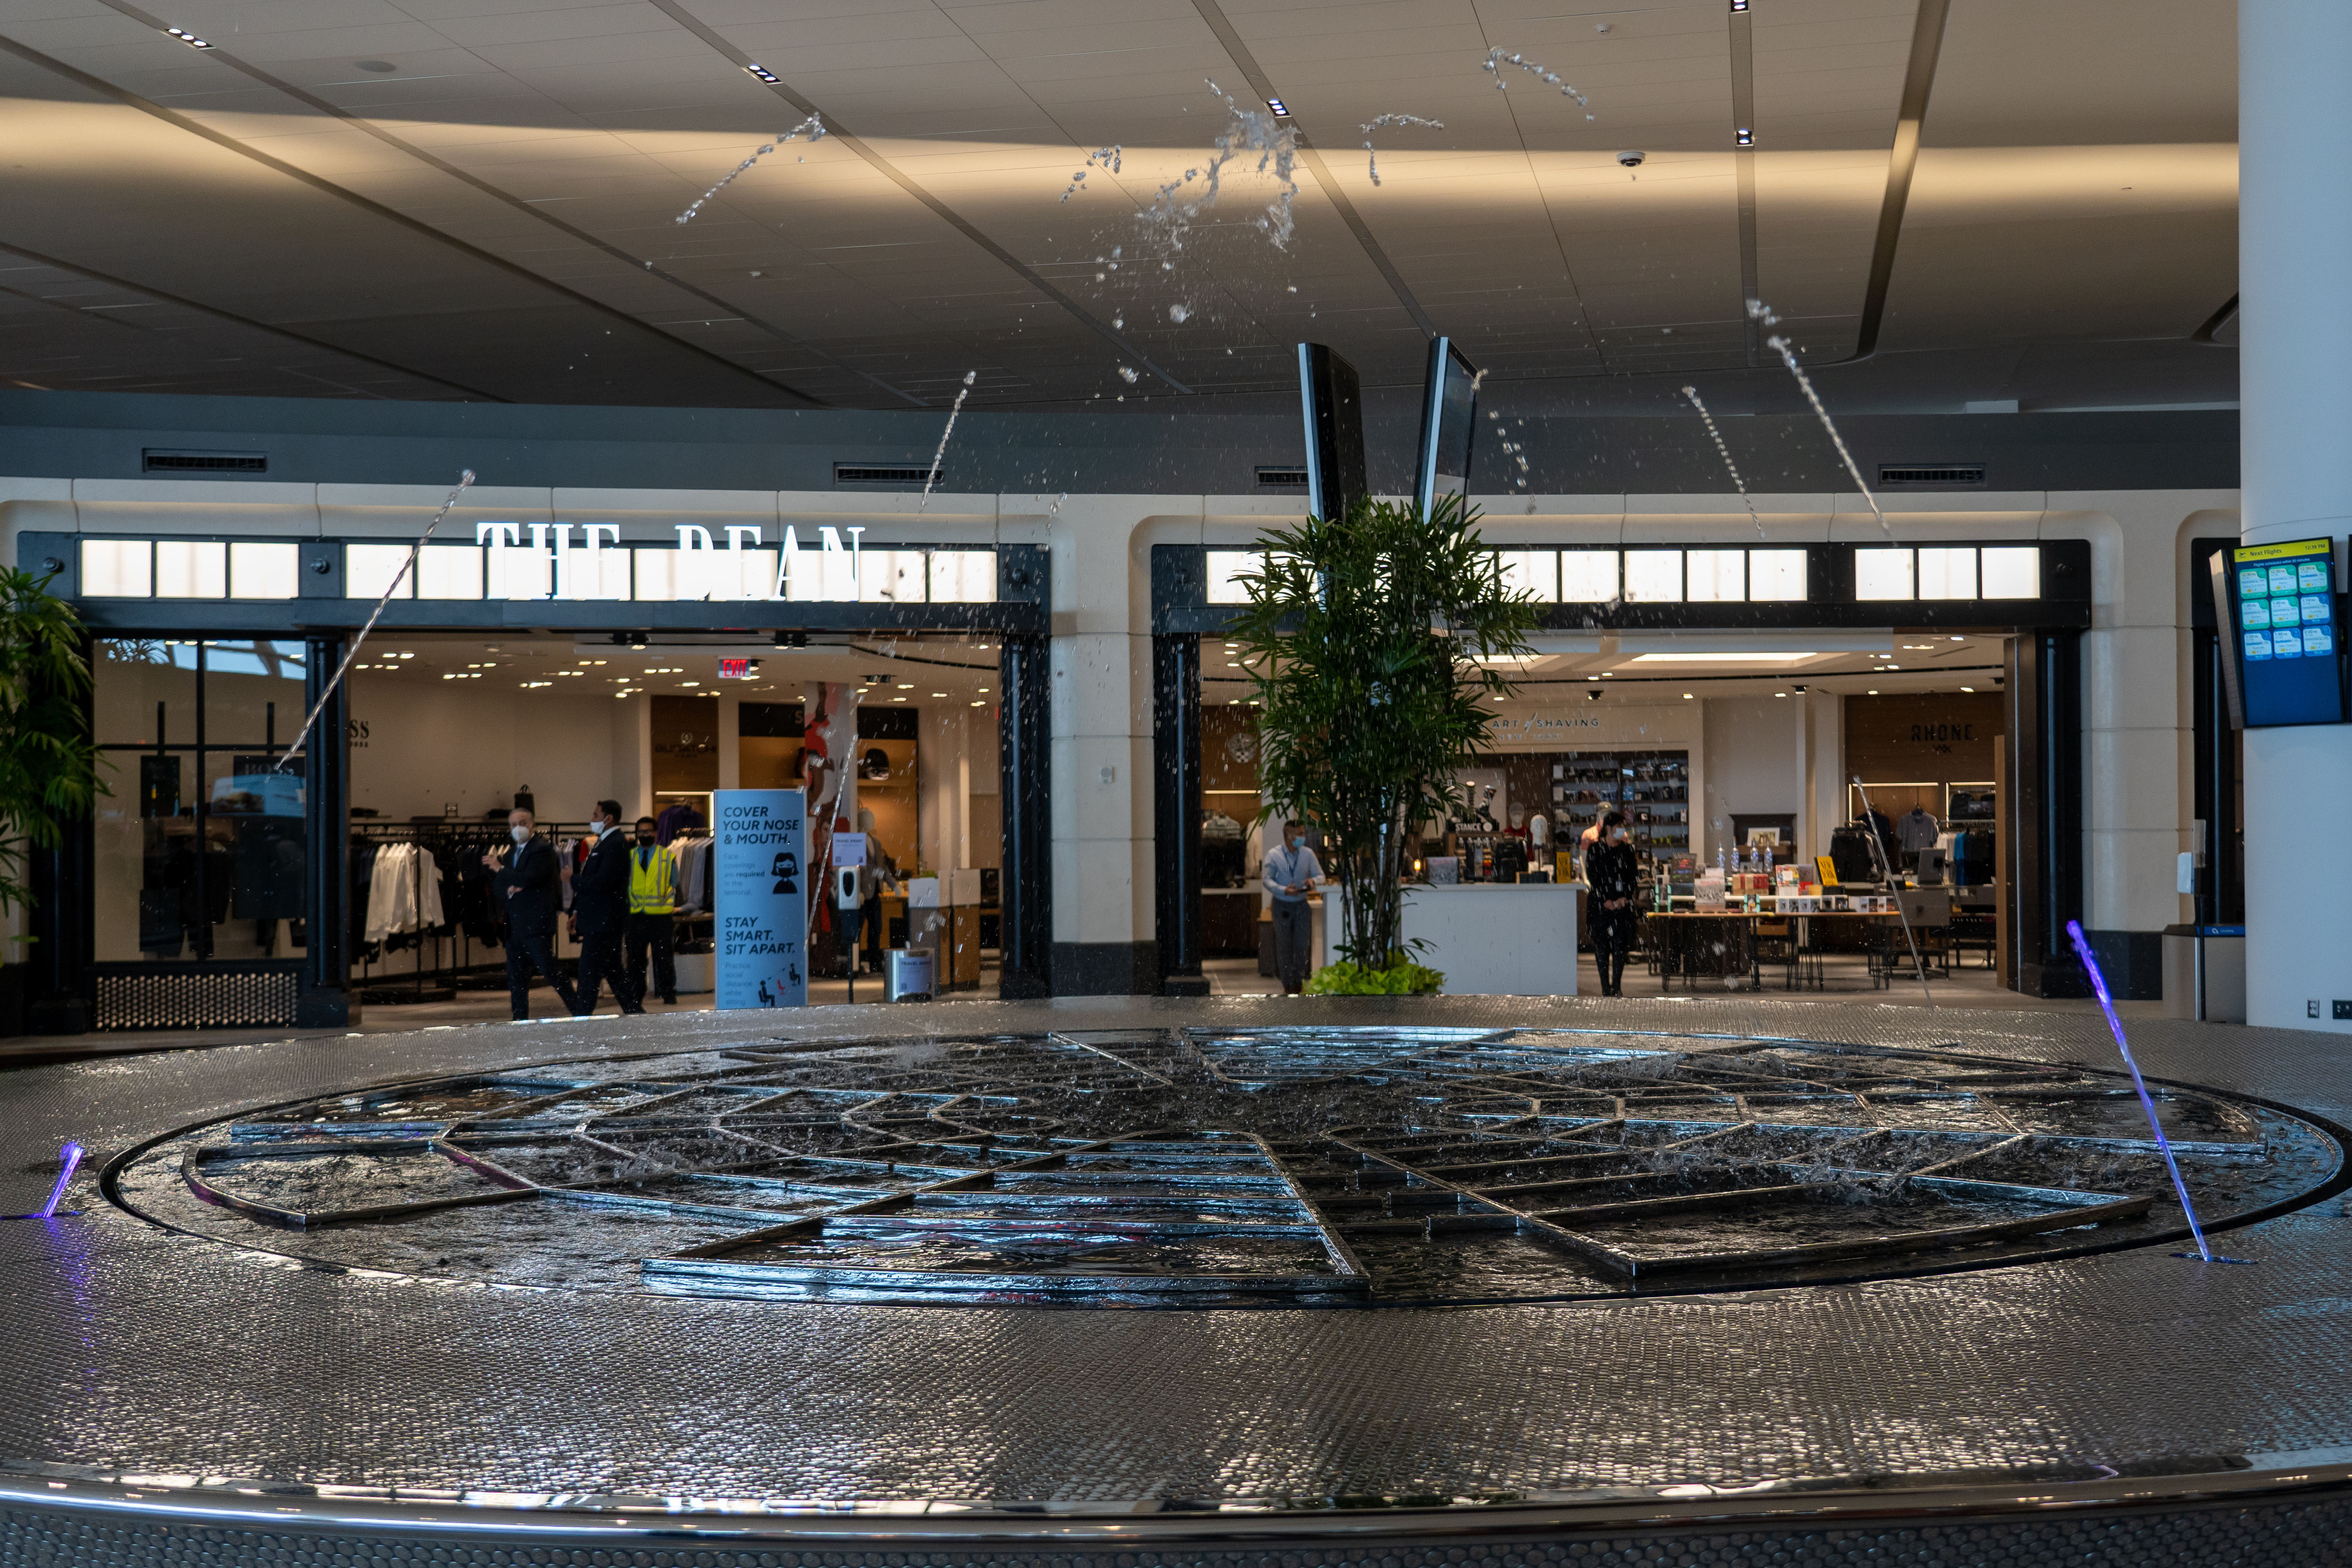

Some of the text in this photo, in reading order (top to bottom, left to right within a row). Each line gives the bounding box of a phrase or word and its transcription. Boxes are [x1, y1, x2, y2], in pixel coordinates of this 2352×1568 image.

[476, 522, 620, 600] THE
[723, 660, 747, 677] EXIT
[1492, 719, 1520, 729] ART
[1537, 718, 1600, 728] SHAVING
[1911, 724, 1973, 742] RHONE
[723, 806, 769, 817] COVER
[723, 820, 799, 831] YOUR NOSE
[1455, 822, 1482, 832] STANCE
[723, 833, 791, 844] & MOUTH.
[736, 870, 765, 879] required
[725, 917, 759, 928] STAY
[725, 930, 774, 941] SMART.
[725, 943, 795, 955] SIT APART.
